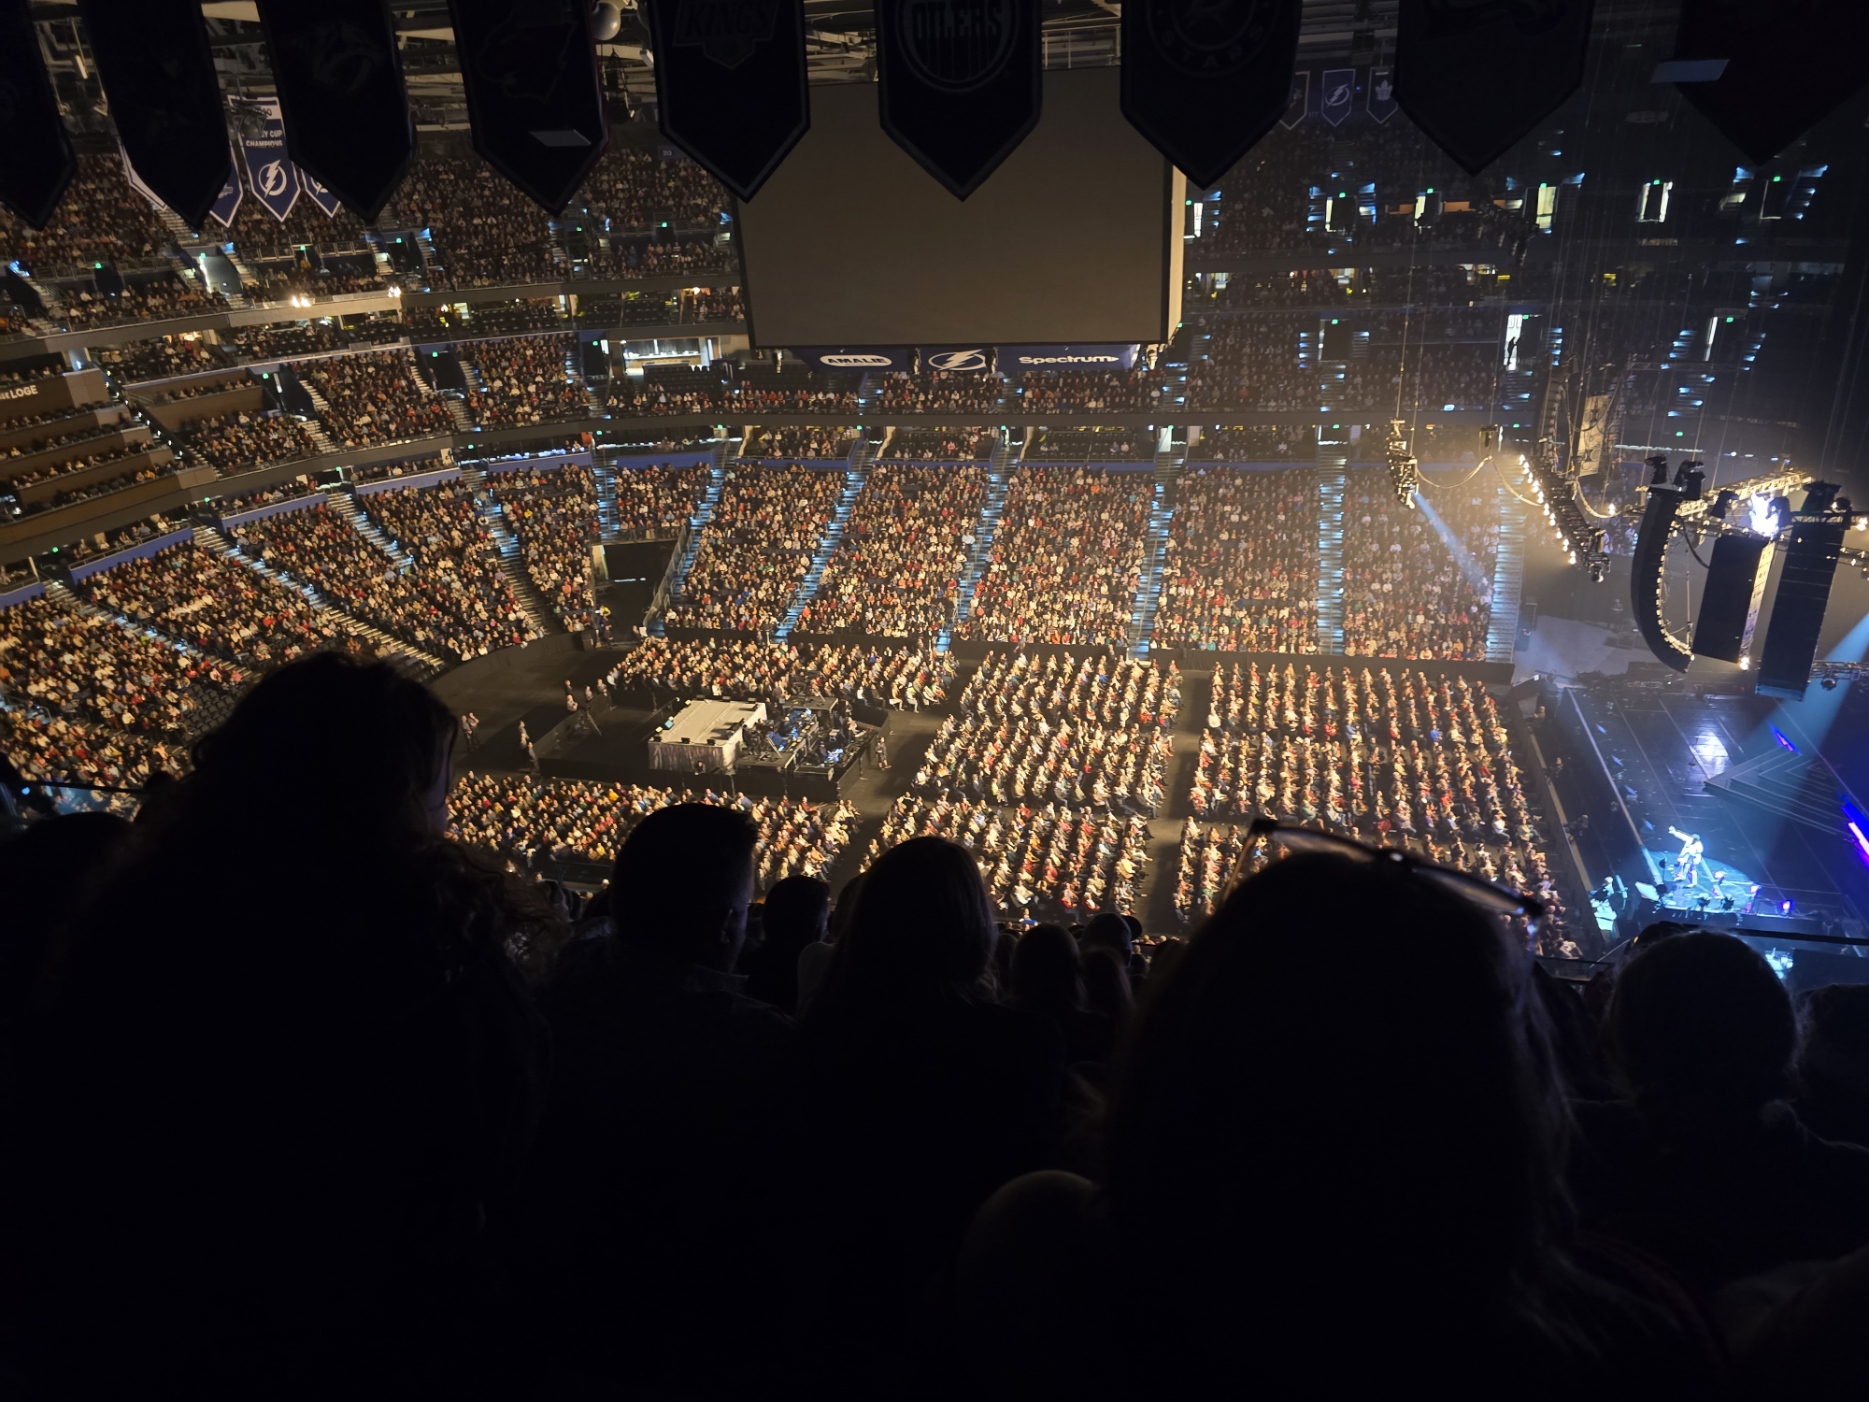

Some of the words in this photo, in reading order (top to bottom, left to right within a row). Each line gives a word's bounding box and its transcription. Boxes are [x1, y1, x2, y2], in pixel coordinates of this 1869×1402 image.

[684, 0, 771, 37] KINGS
[913, 2, 1004, 42] OILERS
[1161, 24, 1264, 68] STARS
[269, 130, 283, 138] CUP
[245, 140, 283, 148] CHAMPIONS
[1018, 355, 1115, 365] Spectrum
[9, 384, 38, 399] LOGE
